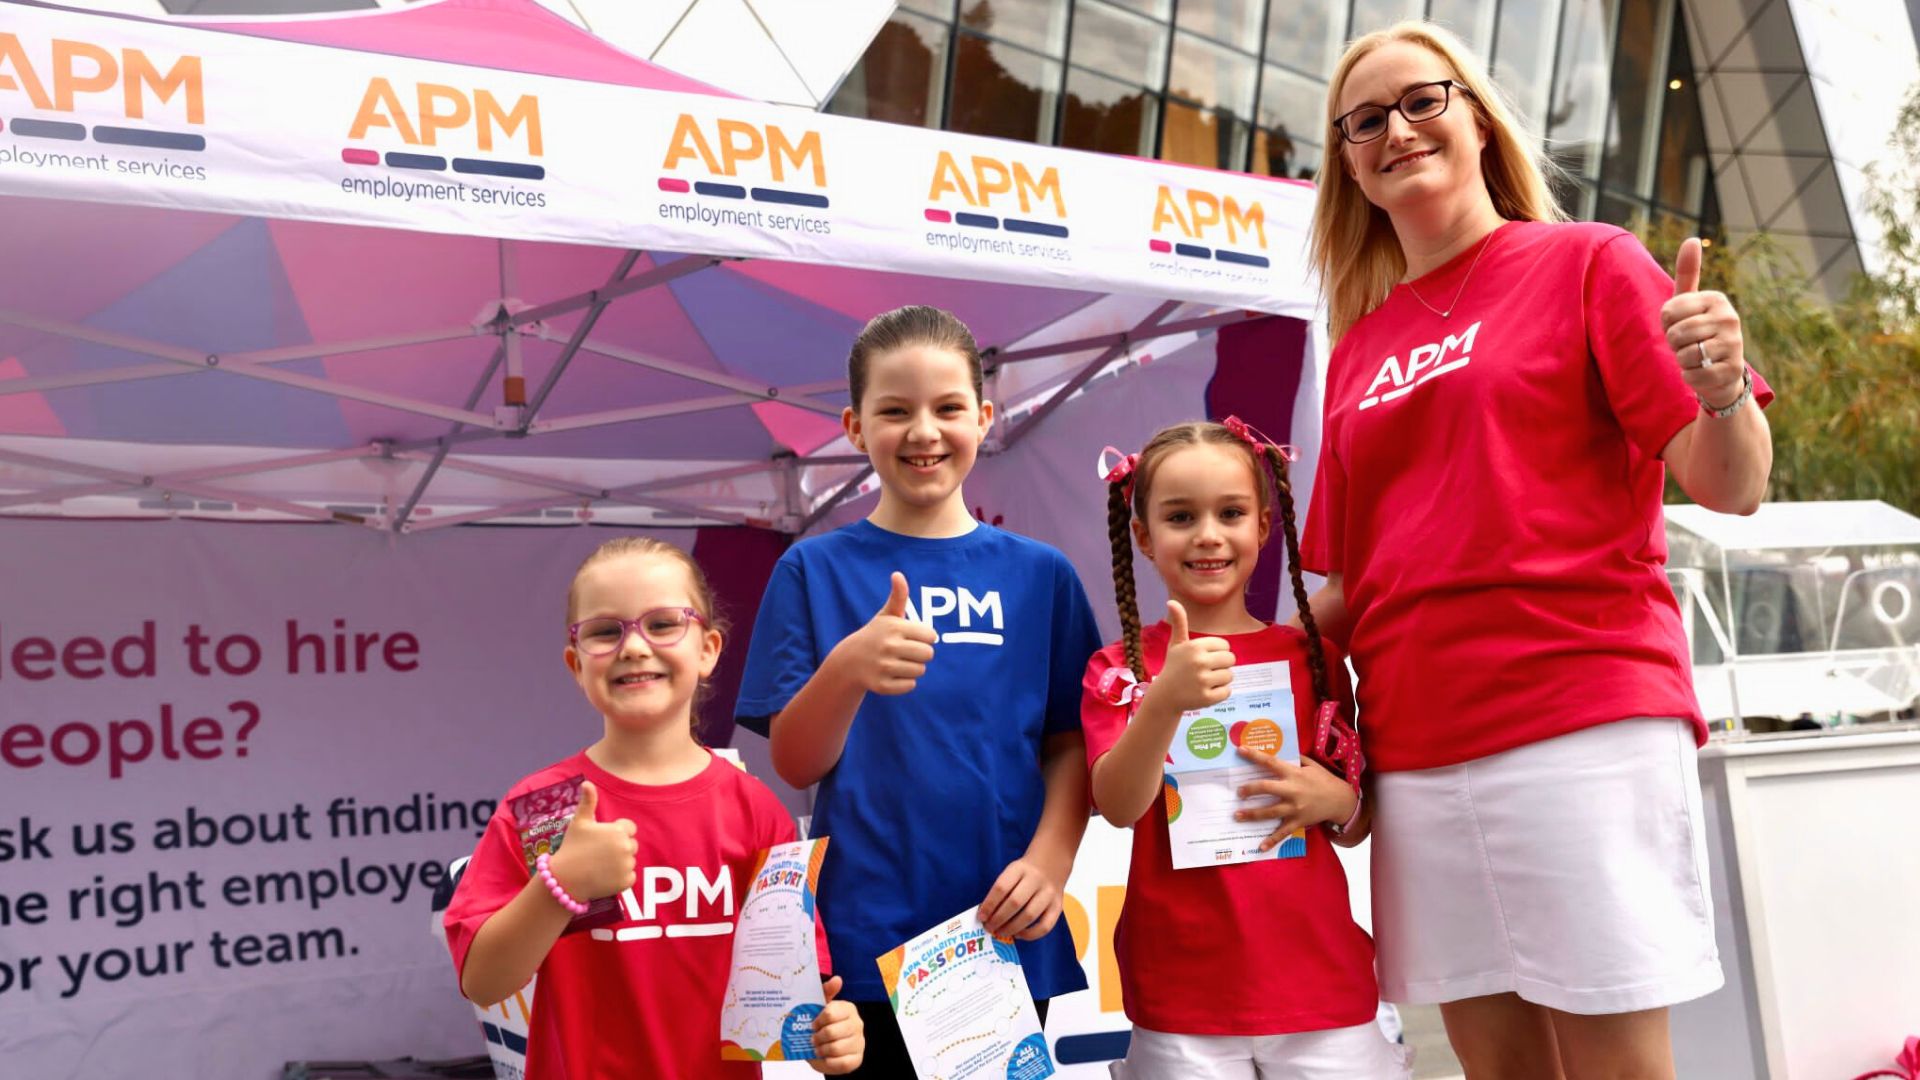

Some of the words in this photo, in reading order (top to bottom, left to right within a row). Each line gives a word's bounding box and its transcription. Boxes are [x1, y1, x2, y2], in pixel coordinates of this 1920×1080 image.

[0, 32, 205, 125] APM
[348, 77, 544, 157] APM
[0, 145, 110, 172] ployment
[116, 158, 207, 181] services
[662, 113, 827, 187] APM
[341, 176, 466, 202] employment
[471, 186, 546, 208] services
[928, 151, 1068, 218] APM
[1152, 185, 1268, 249] APM
[659, 202, 763, 228] employment
[768, 214, 831, 234] services
[926, 231, 1016, 254] employment
[1365, 320, 1482, 396] APM
[0, 620, 156, 681] eed
[183, 624, 262, 676] to
[286, 619, 420, 674] hire
[0, 699, 261, 779] eople?
[0, 817, 53, 862] sk
[72, 821, 136, 856] us
[153, 804, 312, 850] about
[327, 792, 498, 838] finding
[69, 871, 206, 927] right
[222, 856, 445, 910] employe
[756, 870, 803, 894] PASSPORT
[58, 940, 194, 998] your
[209, 927, 359, 968] team.
[903, 961, 921, 979] APM
[921, 936, 958, 962] CHARITY
[960, 928, 986, 941] TRAIL
[907, 937, 985, 989] PASSPORT
